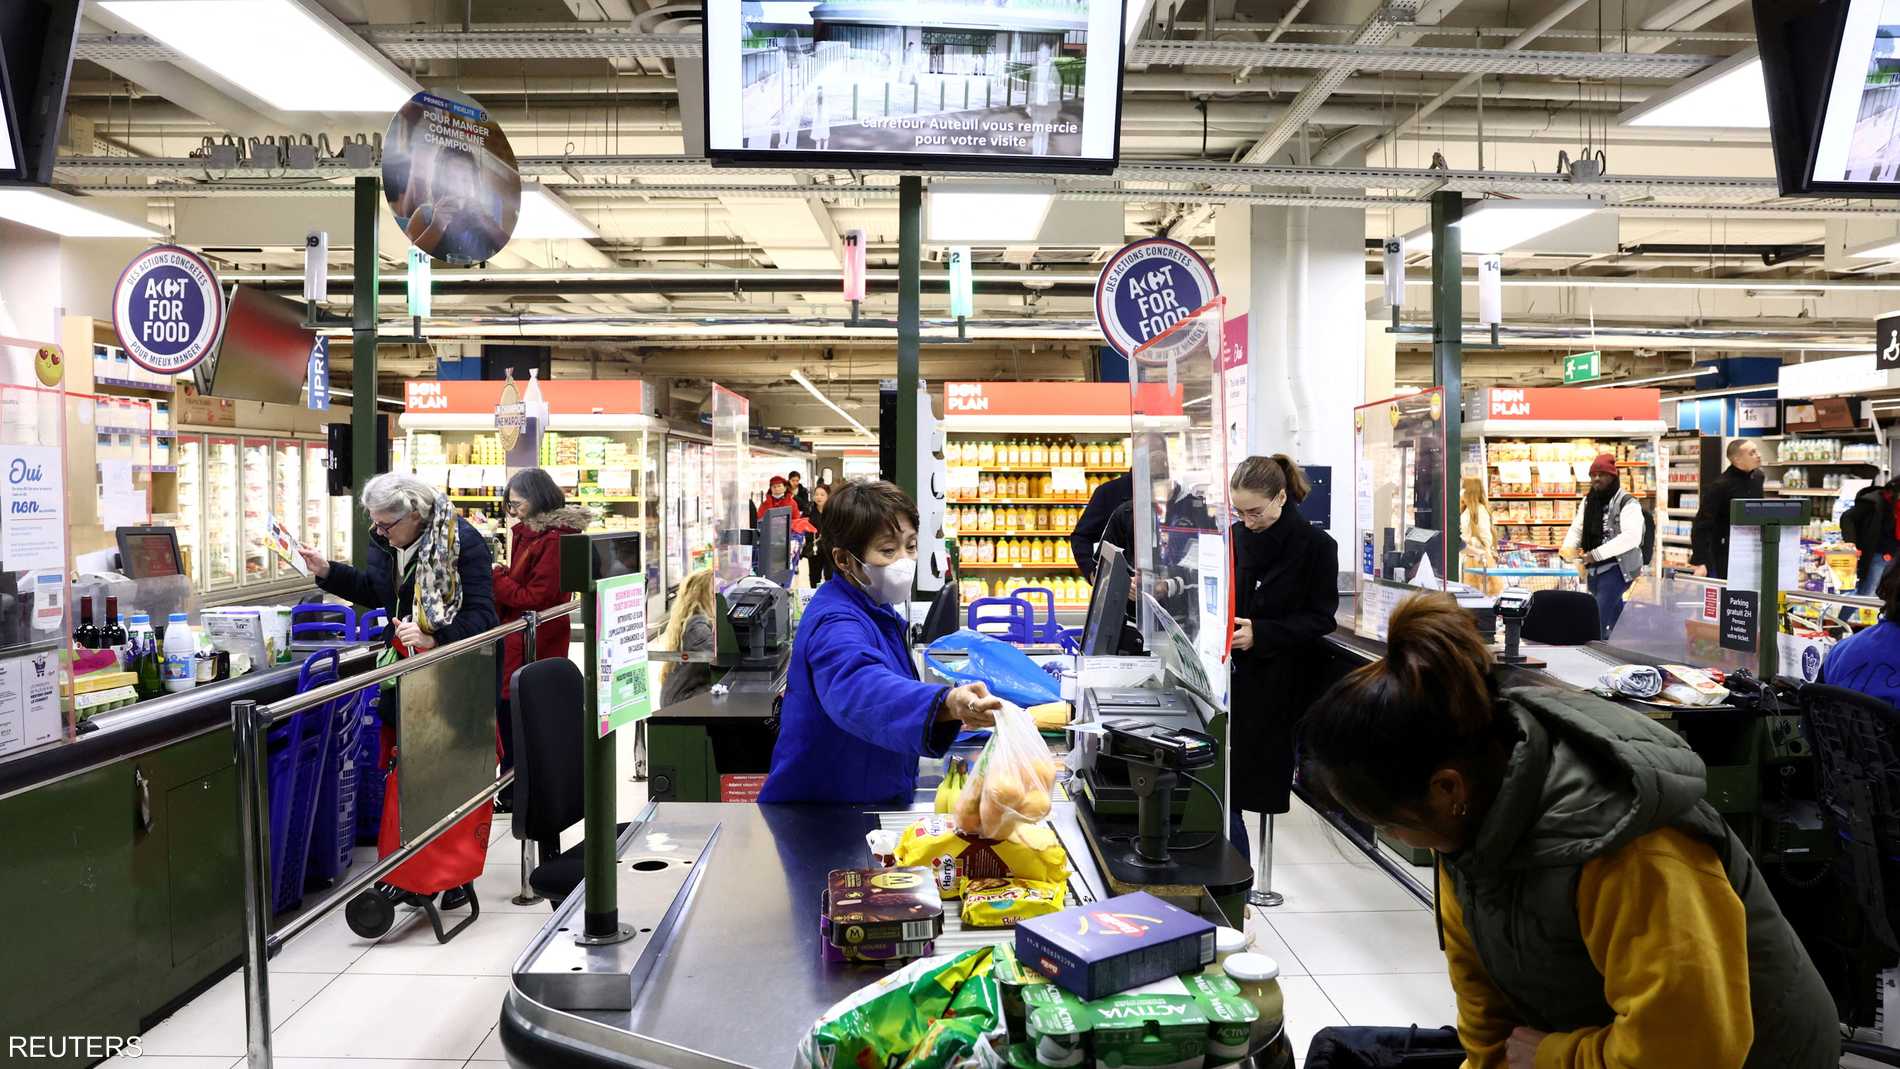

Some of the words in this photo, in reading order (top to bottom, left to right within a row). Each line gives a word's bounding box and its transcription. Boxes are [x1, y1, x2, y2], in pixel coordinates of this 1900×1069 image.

[423, 110, 450, 125] POUR
[452, 118, 489, 137] MANGER
[861, 118, 925, 130] Carrefour
[929, 118, 979, 131] Auteuil
[982, 120, 1014, 132] vous
[1017, 121, 1078, 134] remercie
[429, 123, 465, 139] COMME
[468, 133, 485, 146] UNE
[914, 134, 947, 147] pour
[951, 135, 987, 146] votre
[990, 135, 1027, 147] visite
[424, 133, 480, 153] CHAMPION
[1385, 242, 1400, 254] 13
[140, 254, 169, 271] ACTIONS
[1105, 275, 1117, 293] DES
[1113, 249, 1144, 276] ACTIONS
[1145, 246, 1192, 267] CONCRÈTES
[1484, 261, 1499, 271] 14
[149, 300, 183, 320] FOR
[1137, 289, 1179, 318] FOR
[144, 321, 190, 343] FOOD
[130, 341, 151, 359] POUR
[150, 355, 172, 367] MIEUX
[173, 343, 202, 365] MANGER
[409, 383, 441, 396] BON
[948, 384, 982, 397] BON
[1492, 389, 1524, 402] BON
[409, 396, 448, 409] PLAN
[948, 397, 989, 410] PLAN
[1492, 402, 1531, 416] PLAN
[9, 458, 42, 484] Oui
[11, 500, 40, 514] non
[1730, 597, 1749, 609] Parking
[1726, 607, 1744, 616] gratuit
[1744, 609, 1752, 618] 2H
[1098, 1003, 1187, 1018] ACTIVIA
